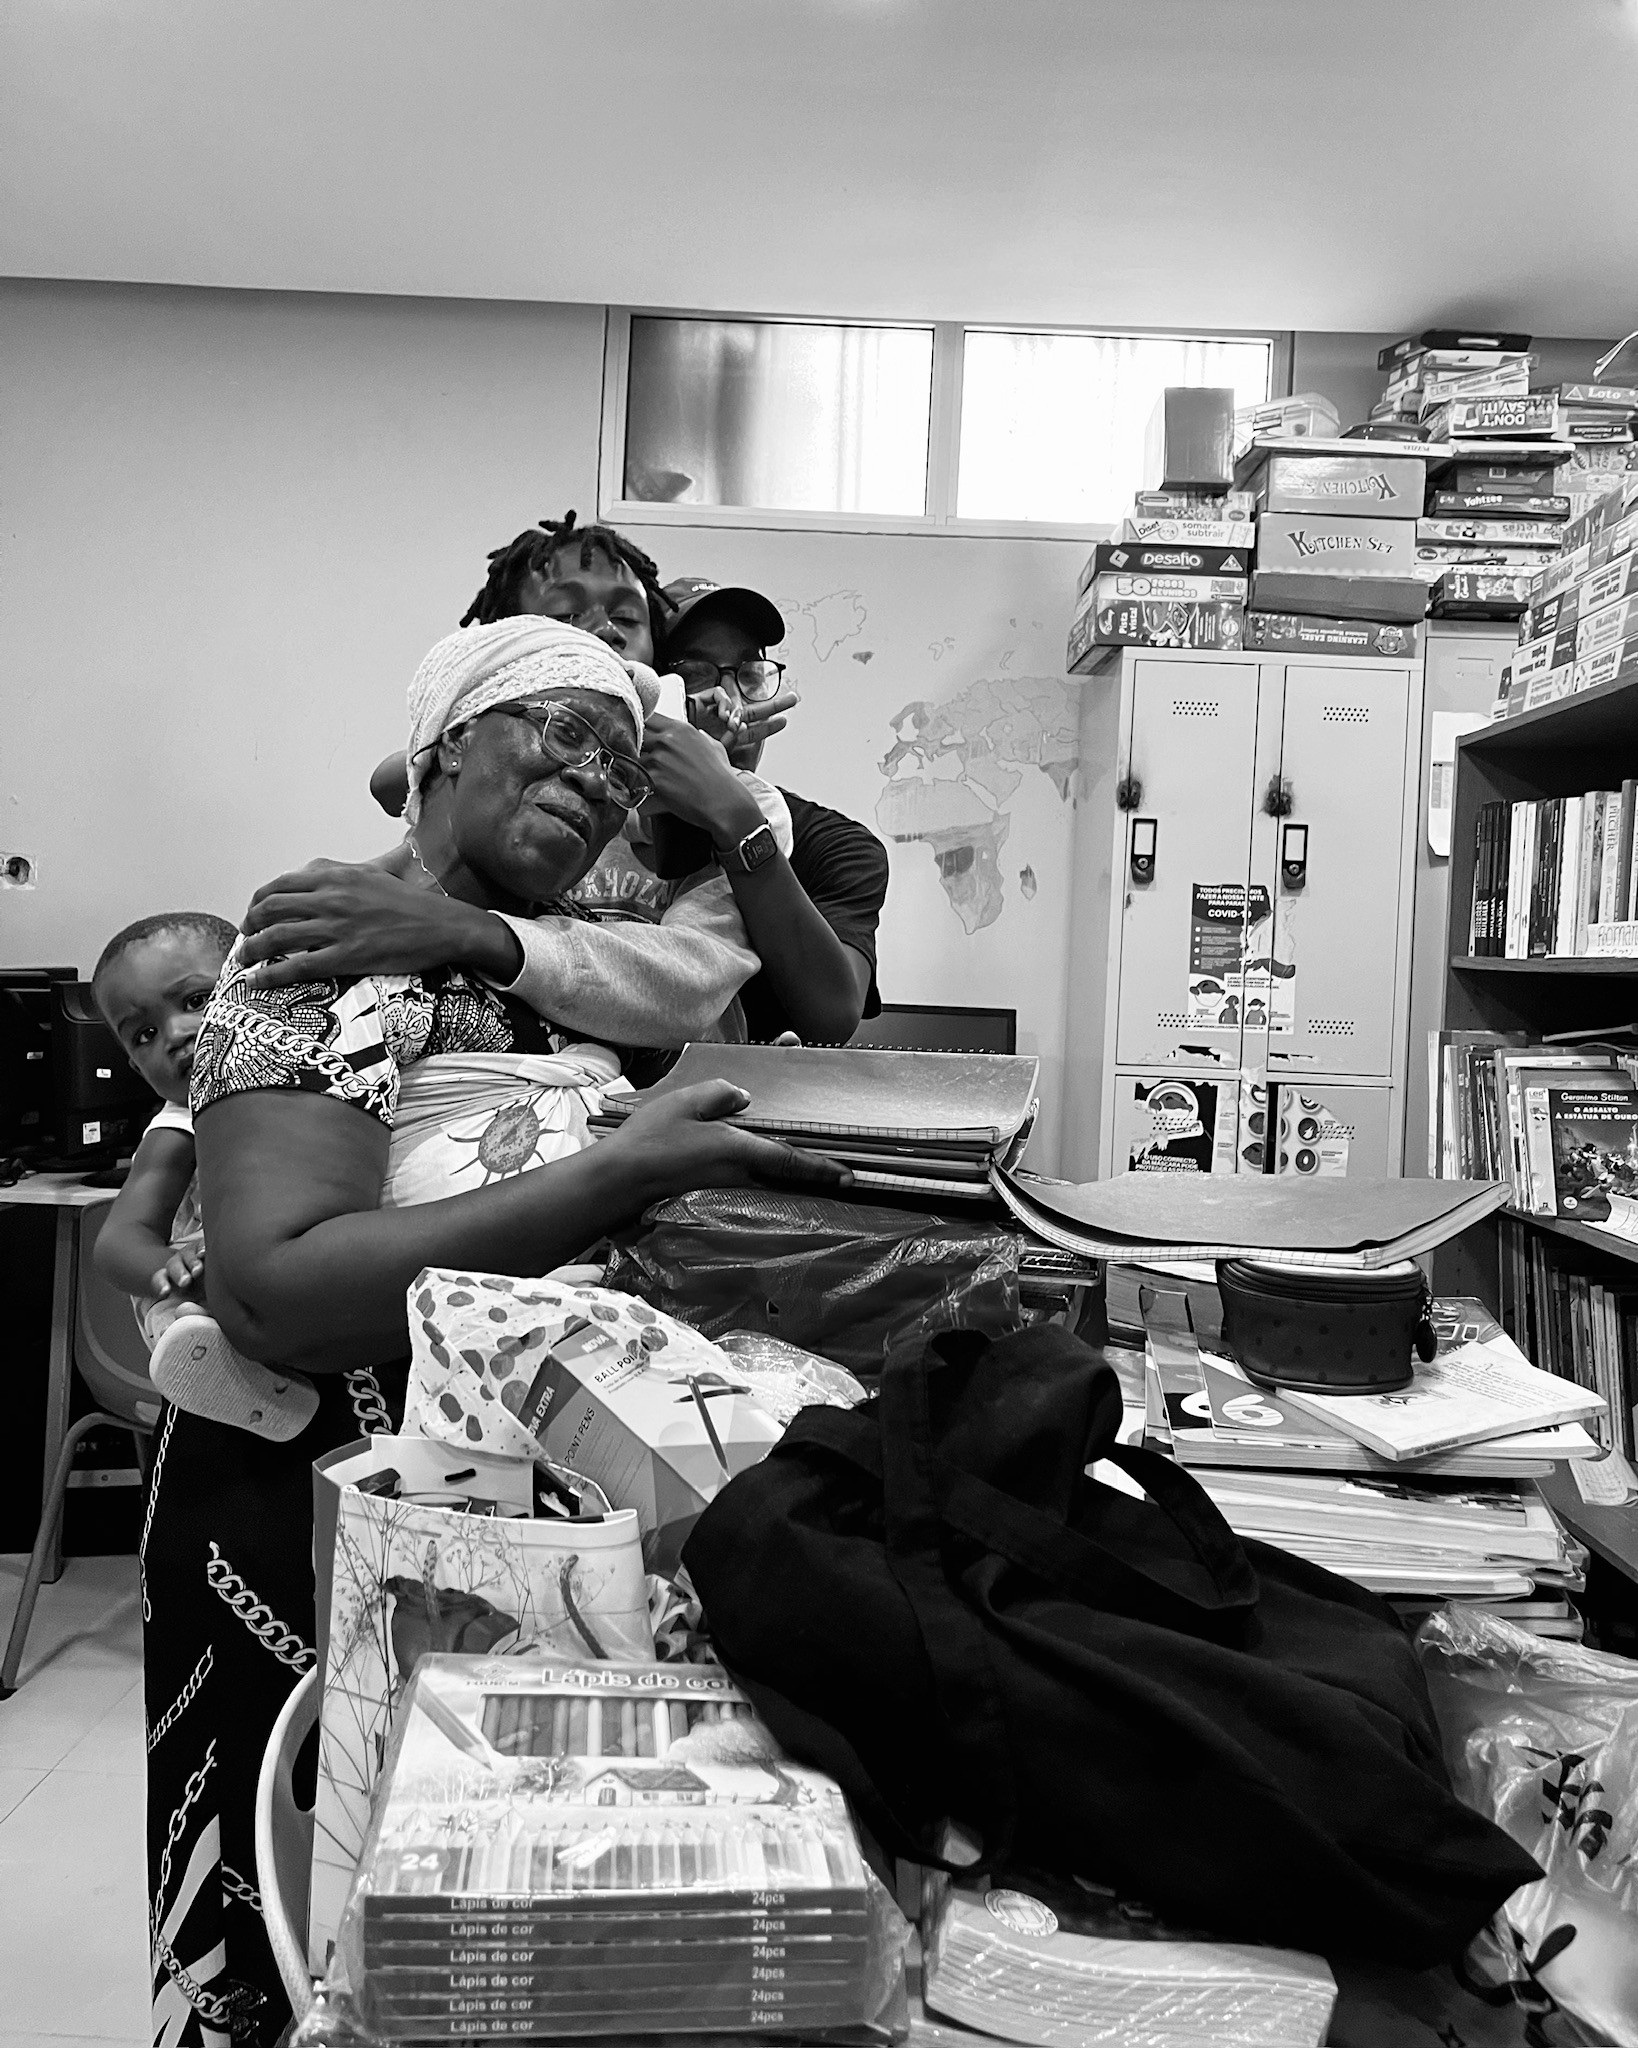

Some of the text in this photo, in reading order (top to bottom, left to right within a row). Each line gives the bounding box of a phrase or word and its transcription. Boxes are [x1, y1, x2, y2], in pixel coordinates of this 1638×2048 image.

[1588, 387, 1621, 400] Loto
[1482, 401, 1527, 414] SAY IT!
[1482, 413, 1526, 427] DON'T
[1322, 473, 1399, 501] KITCHEN
[1463, 495, 1503, 507] Yahtzee
[1138, 521, 1160, 536] Diset
[1182, 521, 1211, 530] somar
[1187, 529, 1225, 538] subtrair
[1287, 530, 1395, 557] KITCHEN SET
[1143, 552, 1202, 568] Desafio
[1116, 576, 1151, 596] 50
[1119, 611, 1128, 635] Pista
[1128, 607, 1138, 631] vista!
[1301, 633, 1368, 645] LEARNING EASEL
[1606, 805, 1618, 851] PILCHER
[1561, 1091, 1599, 1101] Geronimo
[1600, 1092, 1629, 1102] Stilton
[1583, 1106, 1619, 1114] ASSALTO
[1163, 1156, 1197, 1164] CORRECTO
[581, 1334, 610, 1354] NOVA
[594, 1366, 619, 1384] BALL
[535, 1385, 556, 1418] EXTRA
[564, 1406, 596, 1466] POINT PENS
[542, 1668, 631, 1688] Lápis
[638, 1672, 680, 1689] de
[400, 1853, 439, 1871] 24
[491, 1898, 508, 1909] de
[511, 1899, 534, 1909] cor
[752, 1891, 785, 1906] 24pcs
[450, 1919, 785, 1937] Lápis de cor 24pcs
[450, 1945, 785, 1964] Lápis de cor 24pcs
[450, 1966, 785, 1988] Lápis de cor 24pcs
[450, 1989, 784, 2013] Lápis de cor 24pcs
[450, 2010, 783, 2033] Lápis de cor 24pcs
